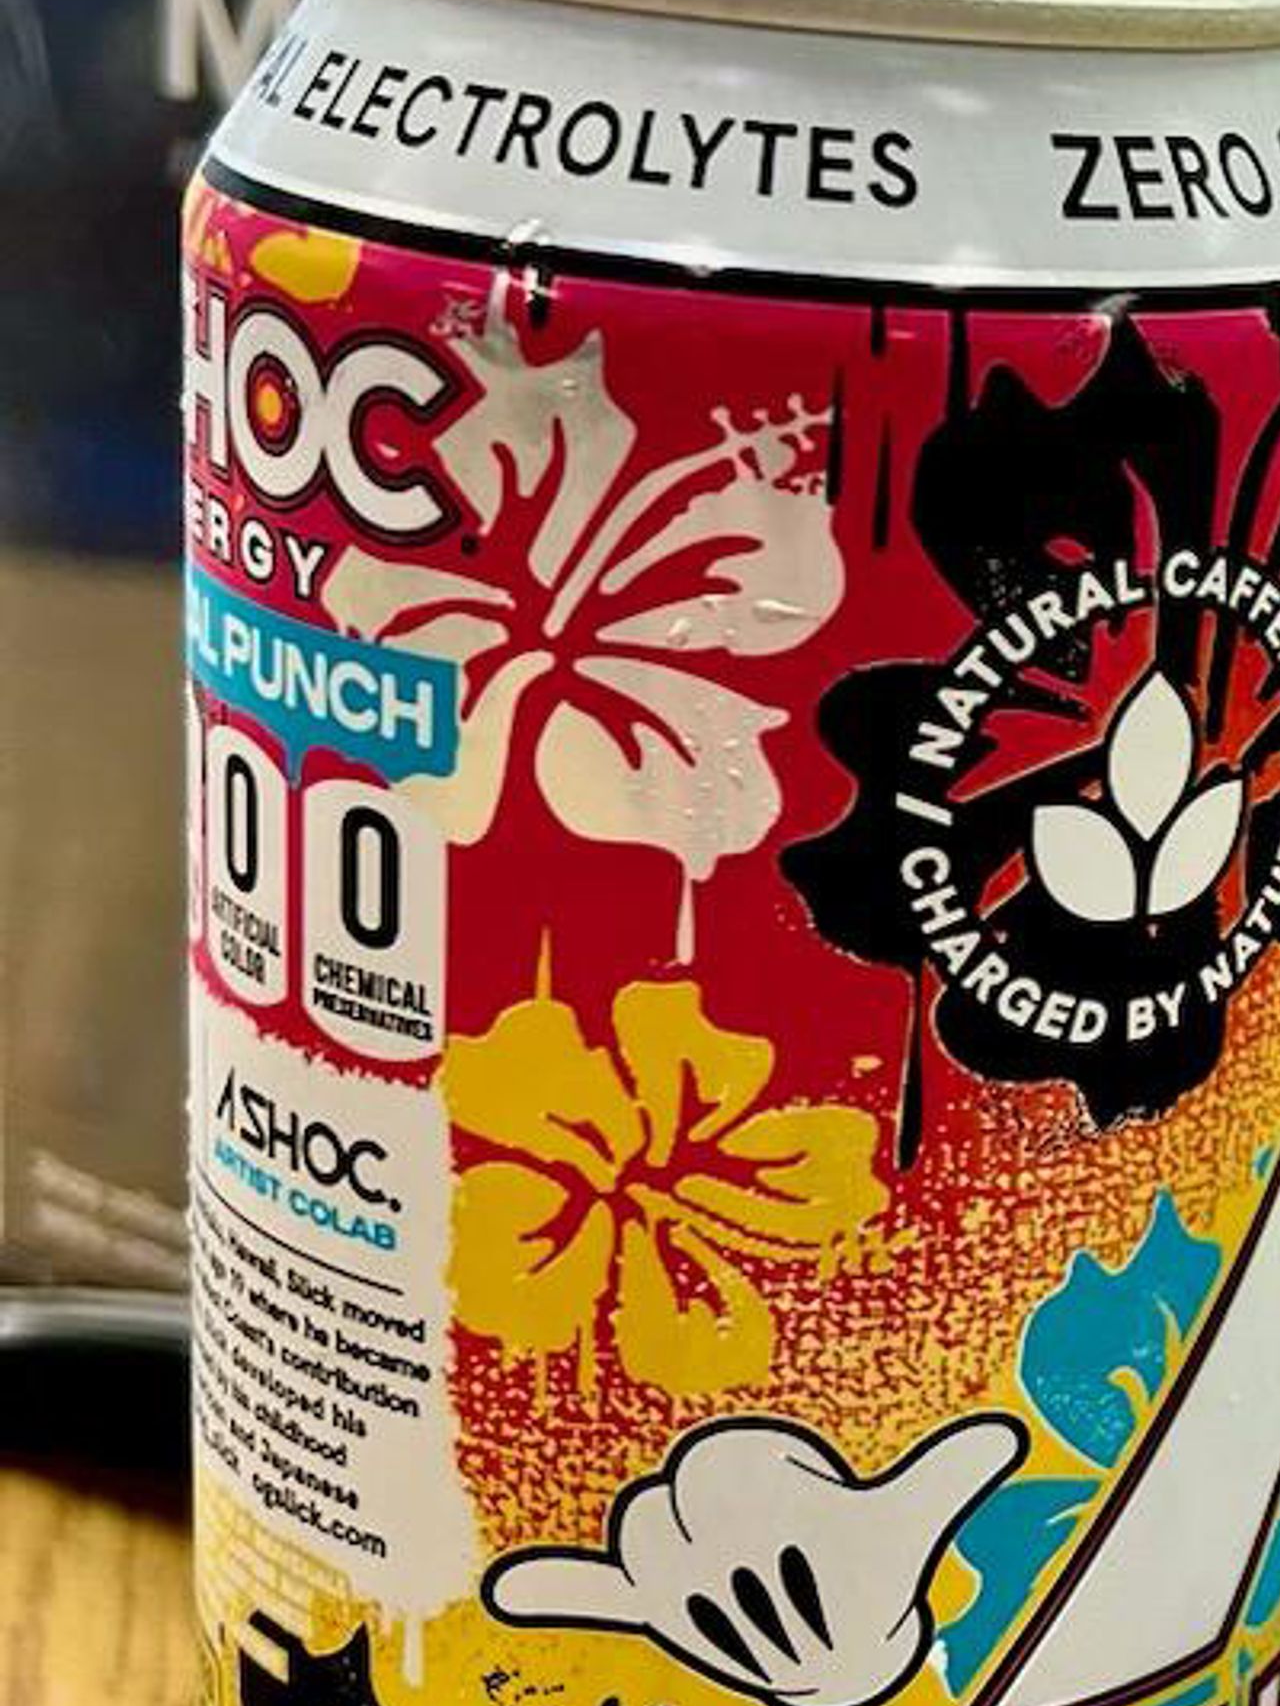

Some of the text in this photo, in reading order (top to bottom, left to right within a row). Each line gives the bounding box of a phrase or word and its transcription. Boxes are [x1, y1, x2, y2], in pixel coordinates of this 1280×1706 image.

[293, 49, 920, 210] ELECTROLYTES
[1050, 131, 1273, 220] ZERO
[221, 619, 435, 750] PUNCH
[910, 559, 1146, 770] NATURAL
[223, 752, 258, 895] 0
[339, 805, 402, 951] 0
[313, 952, 434, 1021] CHEMICAL
[899, 846, 1110, 1044] CHARGED
[1124, 982, 1187, 1042] BY
[312, 988, 435, 1045] PRESERVATIVES
[213, 1135, 282, 1202] ARTIST
[289, 1184, 400, 1251] COLAB
[302, 1314, 330, 1347] he
[335, 1327, 431, 1383] became
[341, 1299, 426, 1344] moved
[280, 1345, 421, 1418] contribution
[331, 1401, 368, 1439] his
